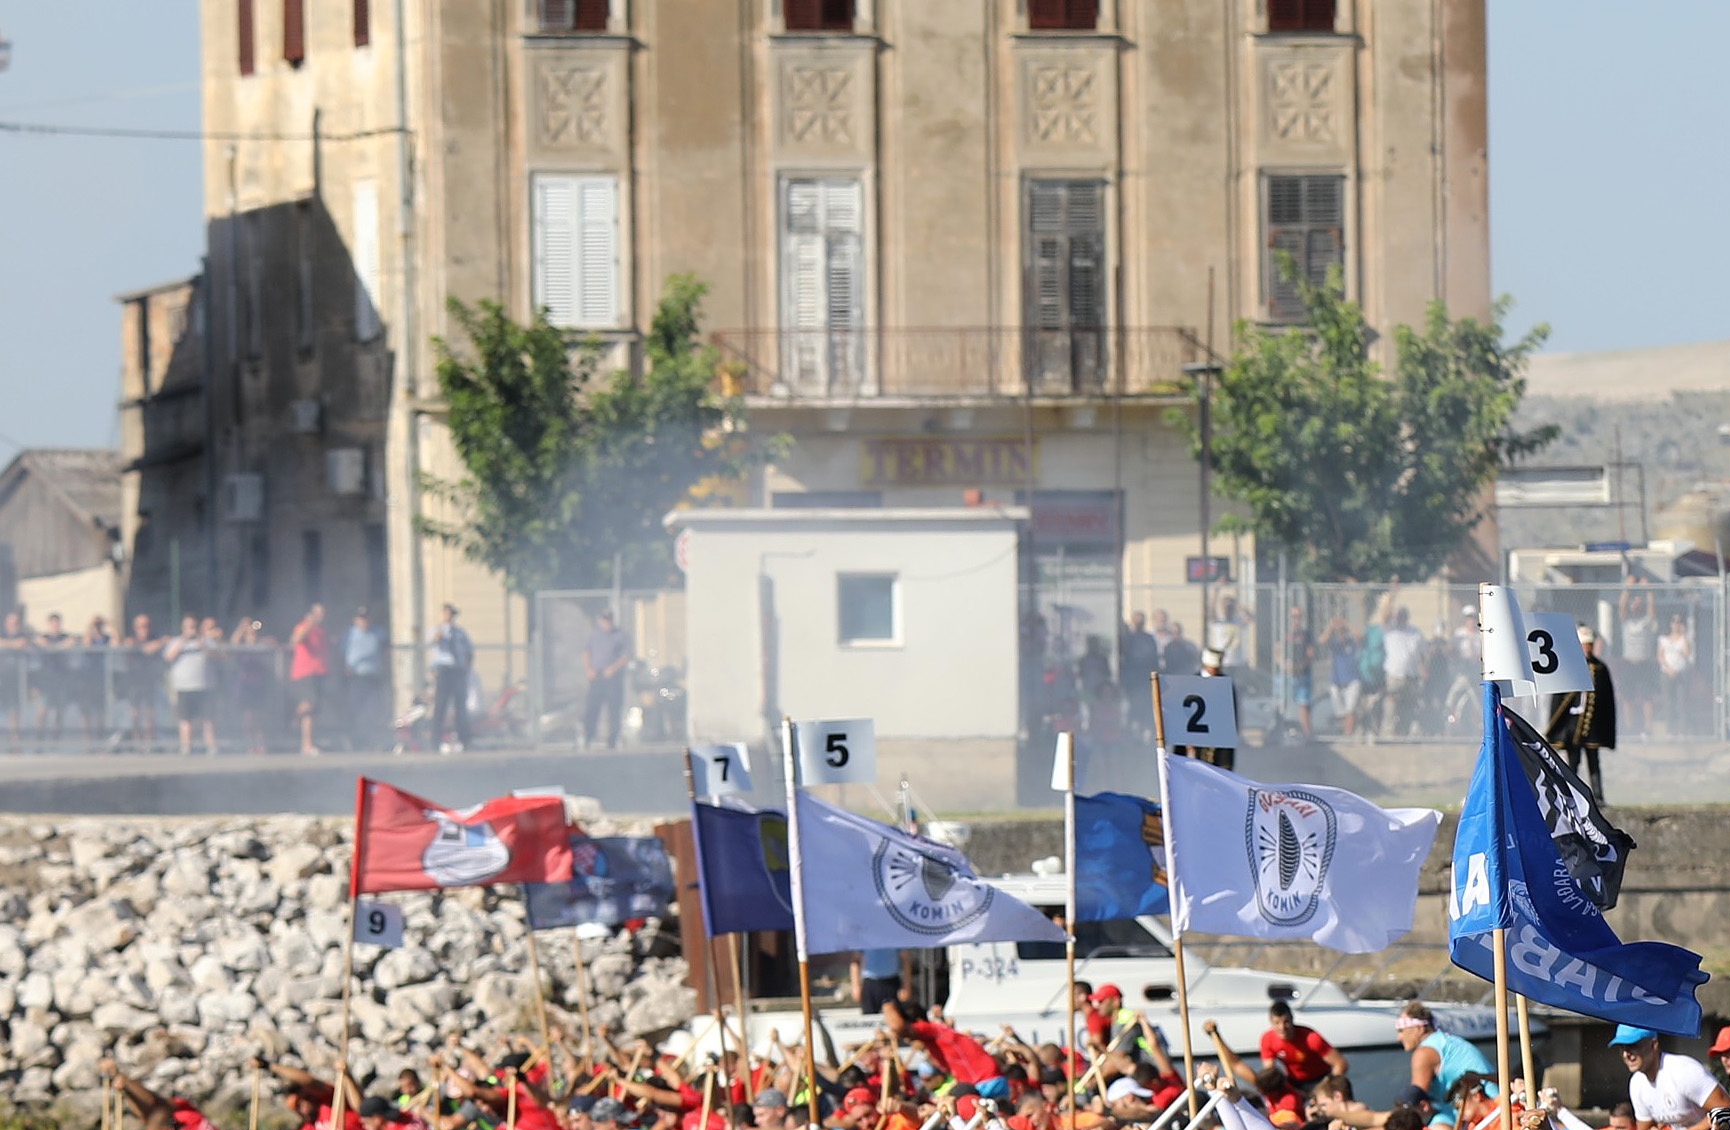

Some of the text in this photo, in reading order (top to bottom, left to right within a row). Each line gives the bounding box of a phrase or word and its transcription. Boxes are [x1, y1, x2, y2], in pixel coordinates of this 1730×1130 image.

[866, 444, 1031, 481] TERMIN
[1527, 629, 1559, 674] 3
[1182, 694, 1209, 733] 2
[826, 733, 849, 769] 5
[714, 757, 731, 781] 7
[910, 901, 964, 920] KOMIN
[1266, 888, 1302, 912] KOMIN
[369, 910, 386, 936] 9
[962, 957, 1018, 980] P-324
